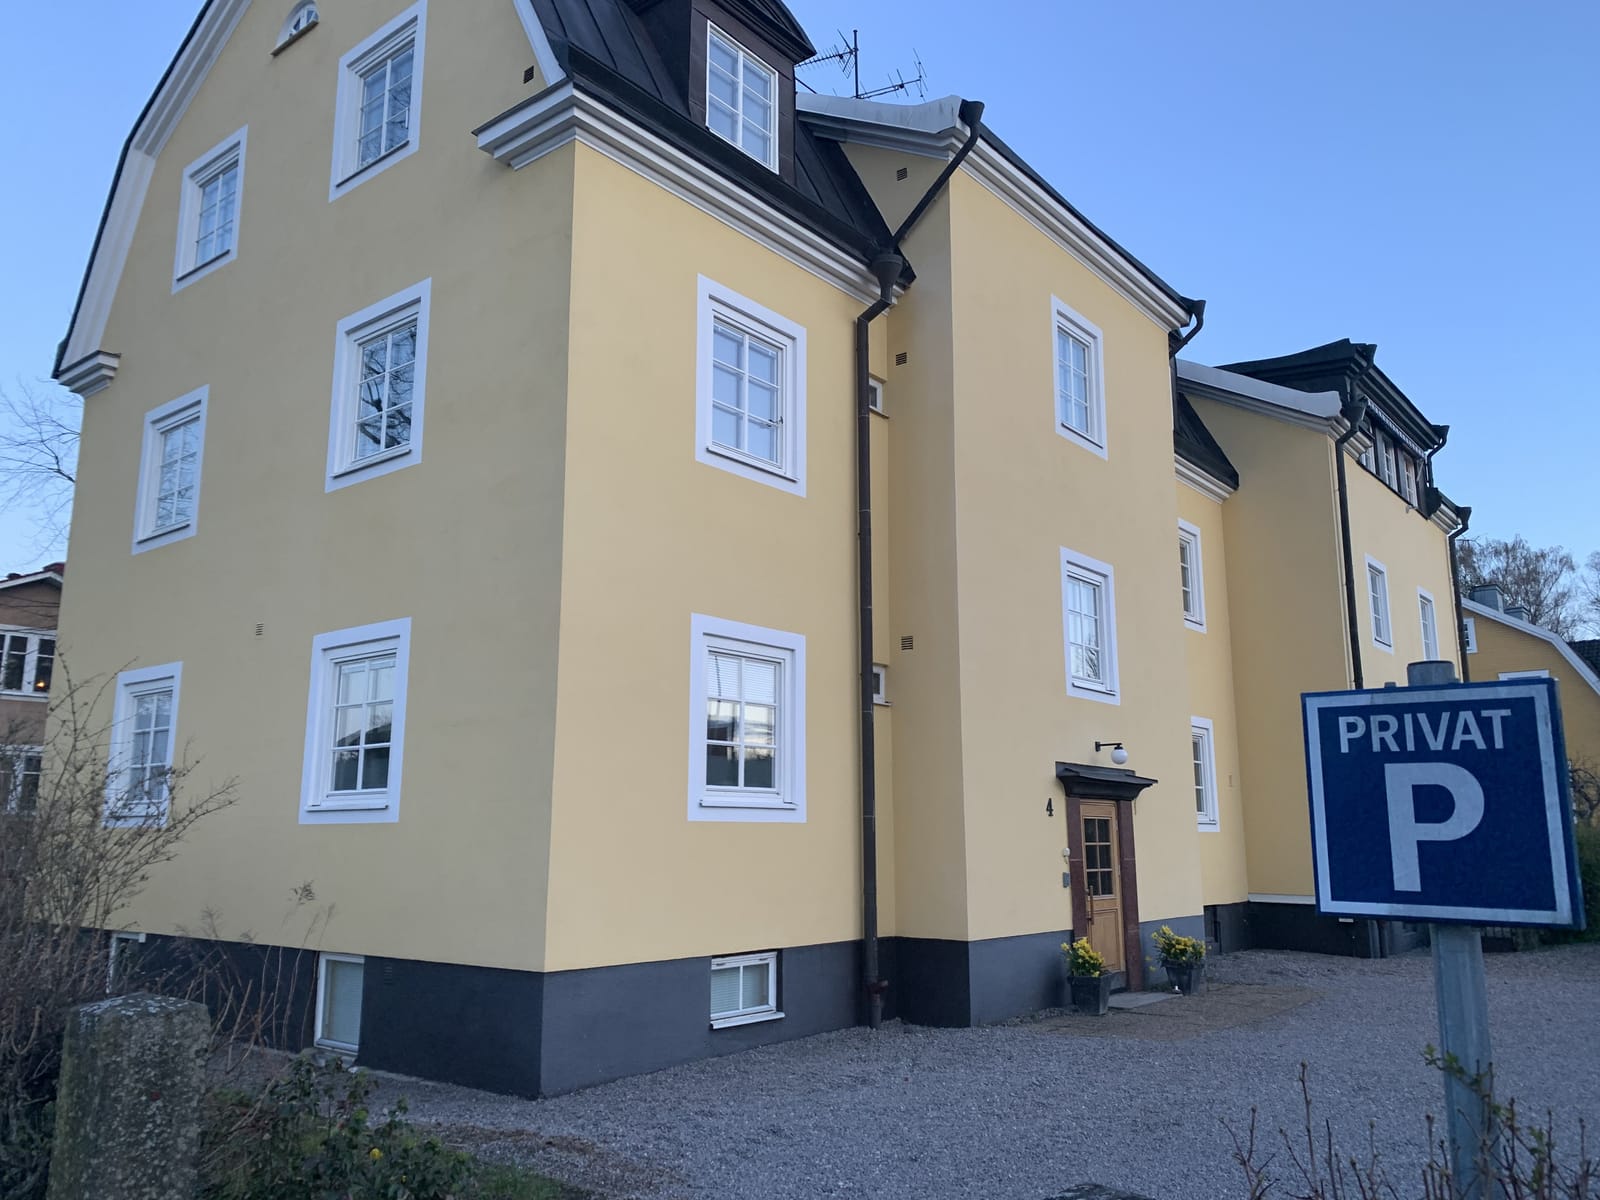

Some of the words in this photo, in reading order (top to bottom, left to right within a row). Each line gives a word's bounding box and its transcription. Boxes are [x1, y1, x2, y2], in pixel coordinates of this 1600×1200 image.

[1338, 709, 1512, 753] PRIVAT
[1046, 798, 1054, 816] 4
[1384, 762, 1485, 892] P
